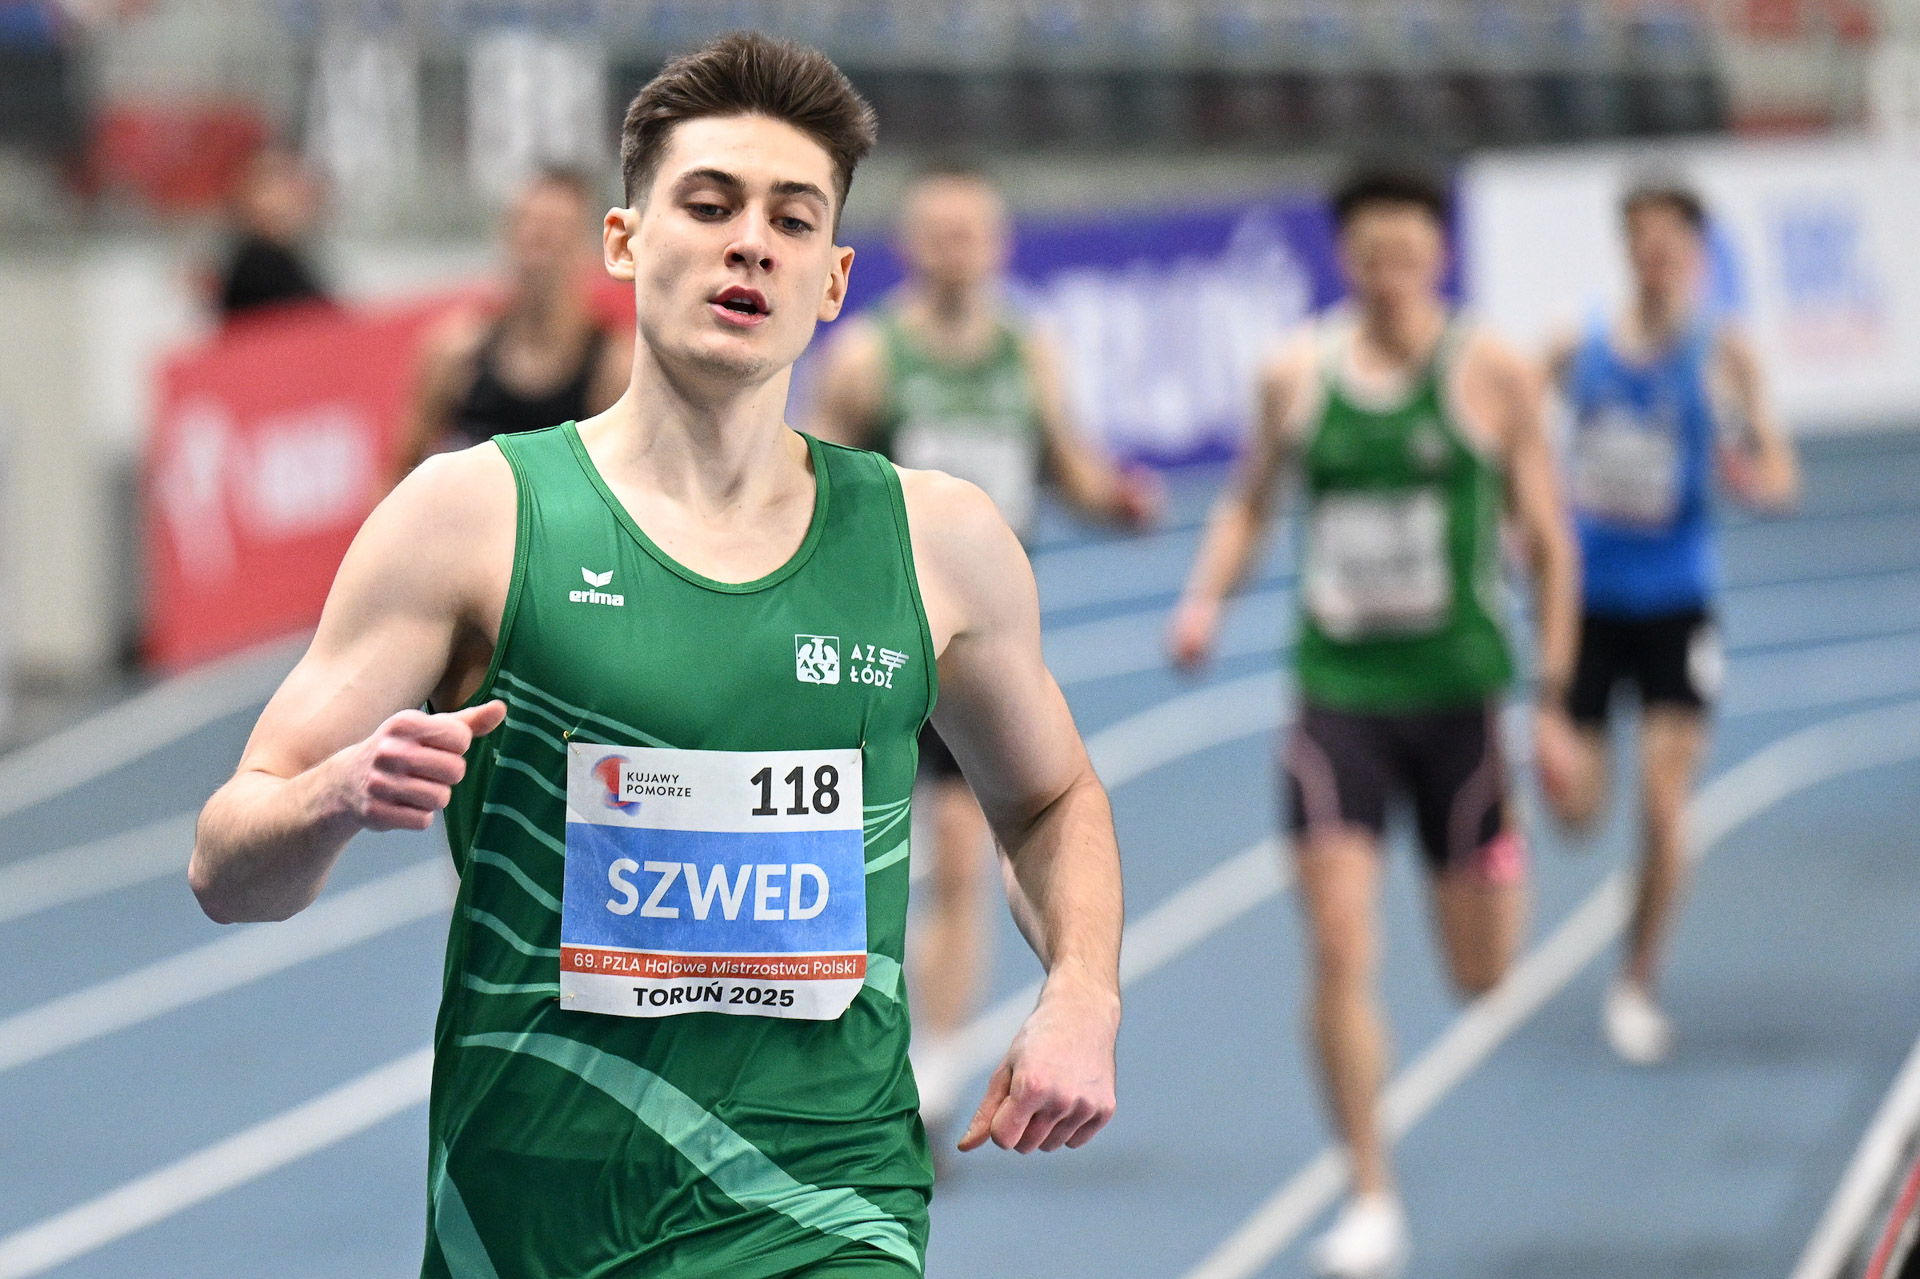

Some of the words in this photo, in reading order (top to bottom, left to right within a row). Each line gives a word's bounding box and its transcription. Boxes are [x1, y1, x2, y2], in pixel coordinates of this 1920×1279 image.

[568, 588, 625, 607] erima
[849, 664, 894, 690] ŁÓDŹ
[626, 771, 680, 785] KUJAWY
[750, 765, 840, 816] 118
[626, 784, 692, 798] POMORZE
[605, 858, 830, 921] SZWED
[573, 952, 599, 970] 69.
[602, 955, 641, 973] PZLA
[644, 958, 707, 974] Halowe
[710, 959, 809, 976] Mistrzostwa
[812, 958, 857, 976] Polski
[632, 981, 723, 1007] TORUŃ
[728, 986, 795, 1008] 2025
